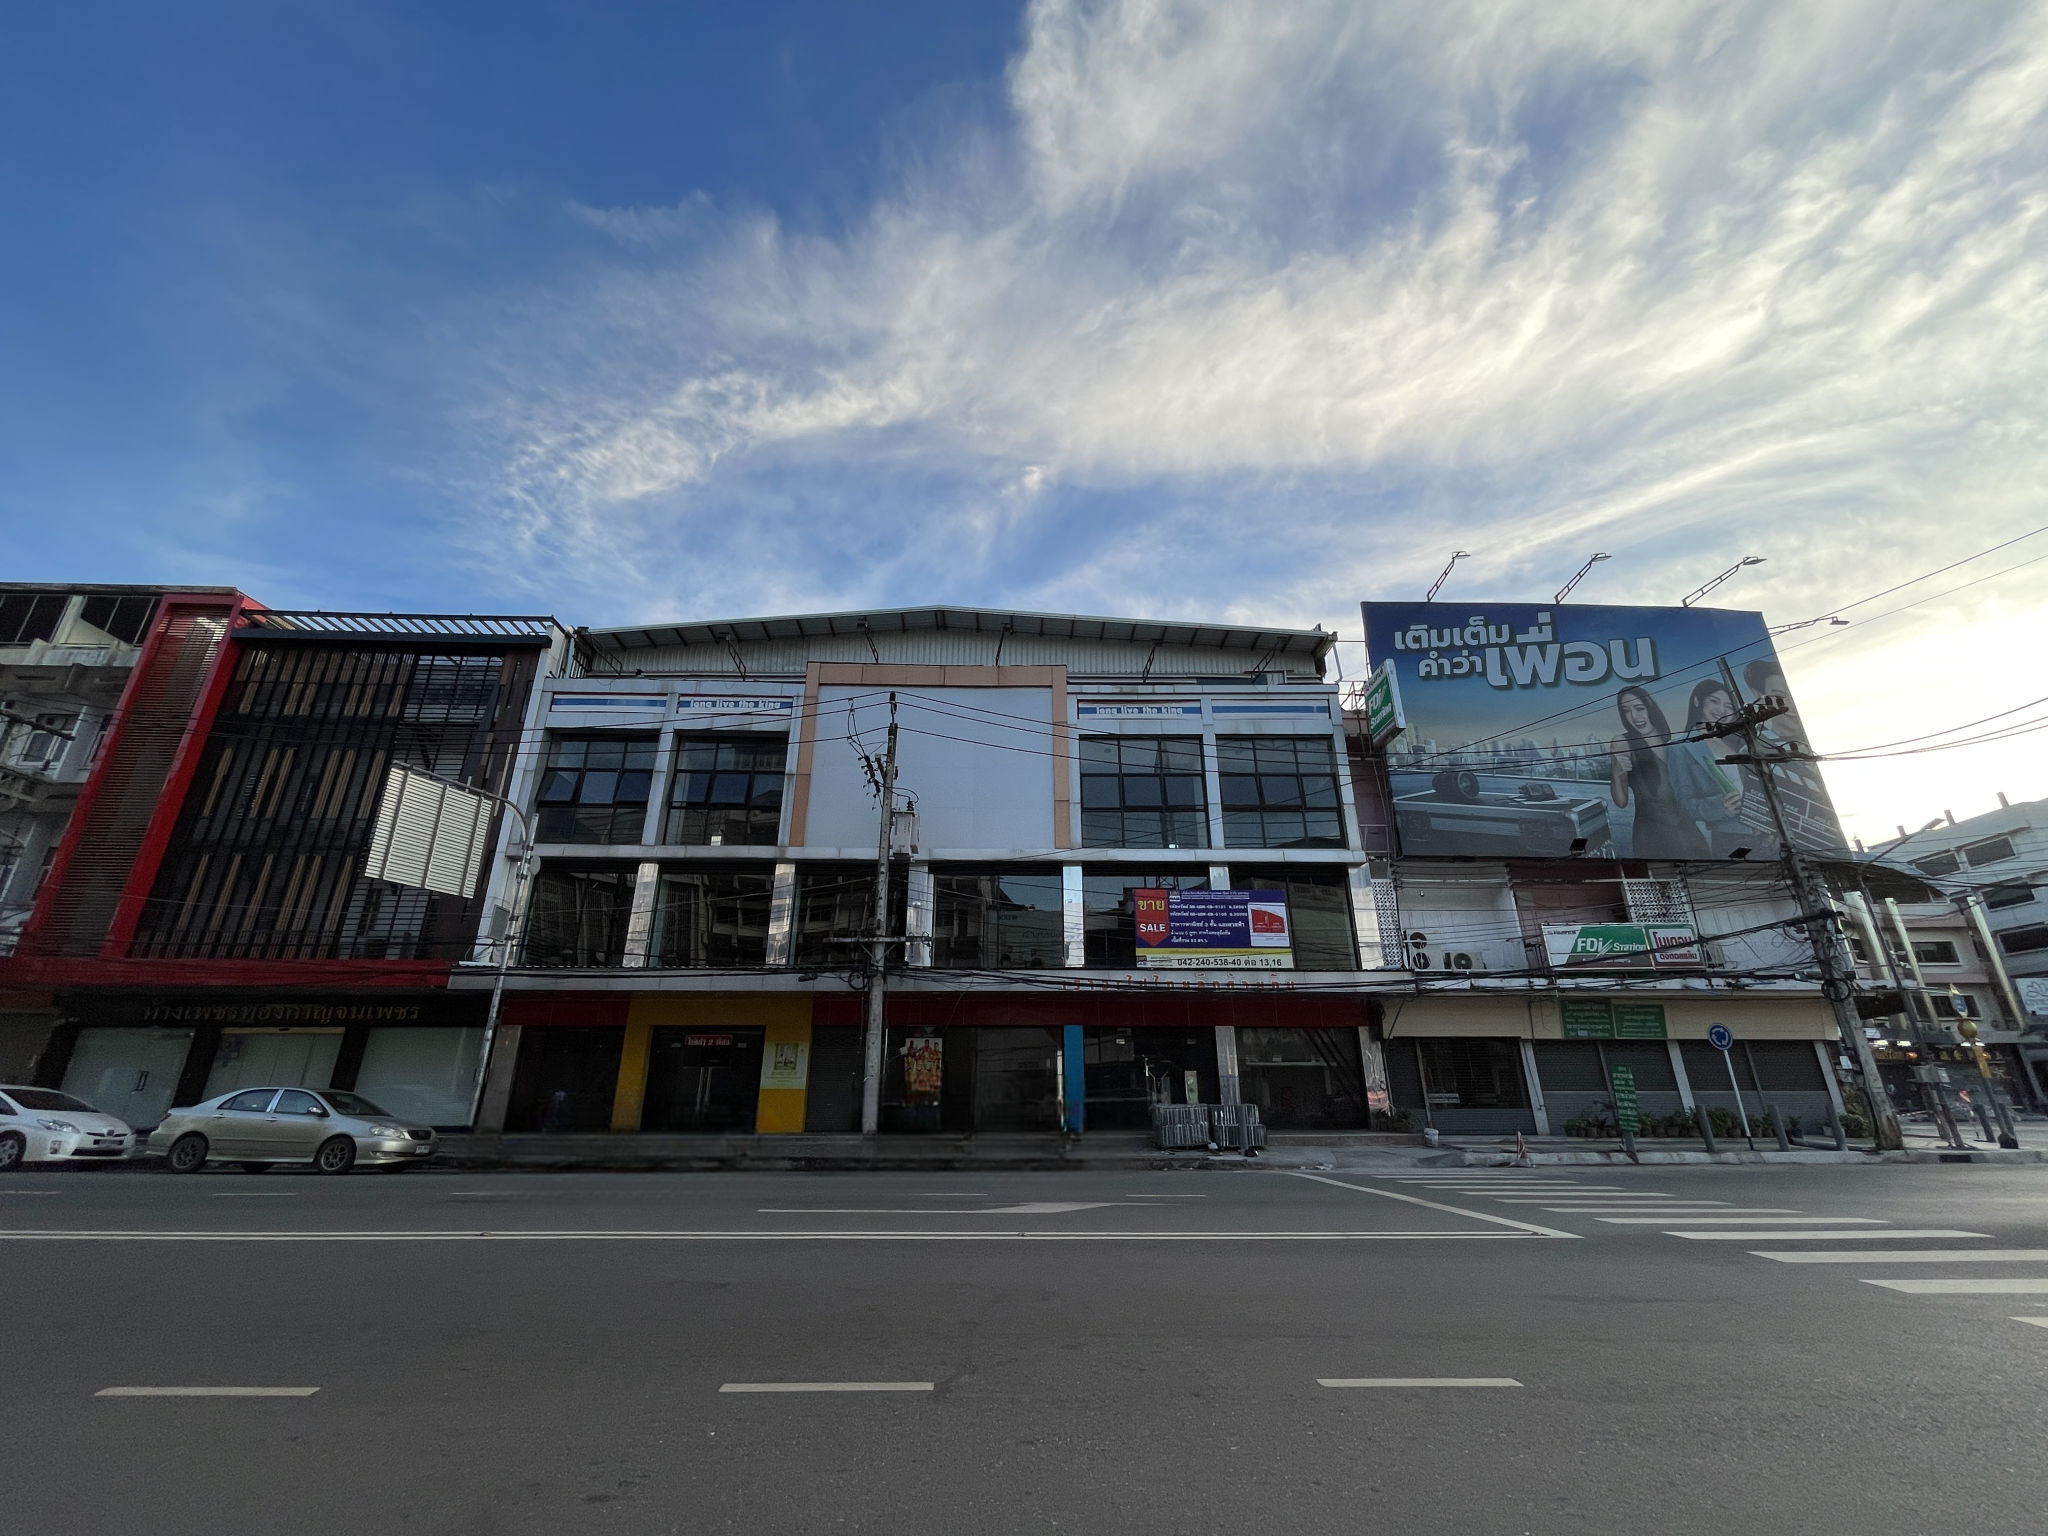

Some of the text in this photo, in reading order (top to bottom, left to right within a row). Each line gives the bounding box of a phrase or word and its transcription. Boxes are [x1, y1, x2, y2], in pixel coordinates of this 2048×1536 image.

[1395, 616, 1510, 650] เติมเต็ม
[1418, 611, 1656, 687] คำว่า เพื่อน
[690, 698, 781, 710] long live the king
[1096, 705, 1183, 717] long live the king
[1138, 899, 1164, 911] ขาย
[1140, 923, 1166, 932] SALE
[1577, 938, 1603, 952] FDi
[1177, 958, 1242, 966] 042-240-538-40
